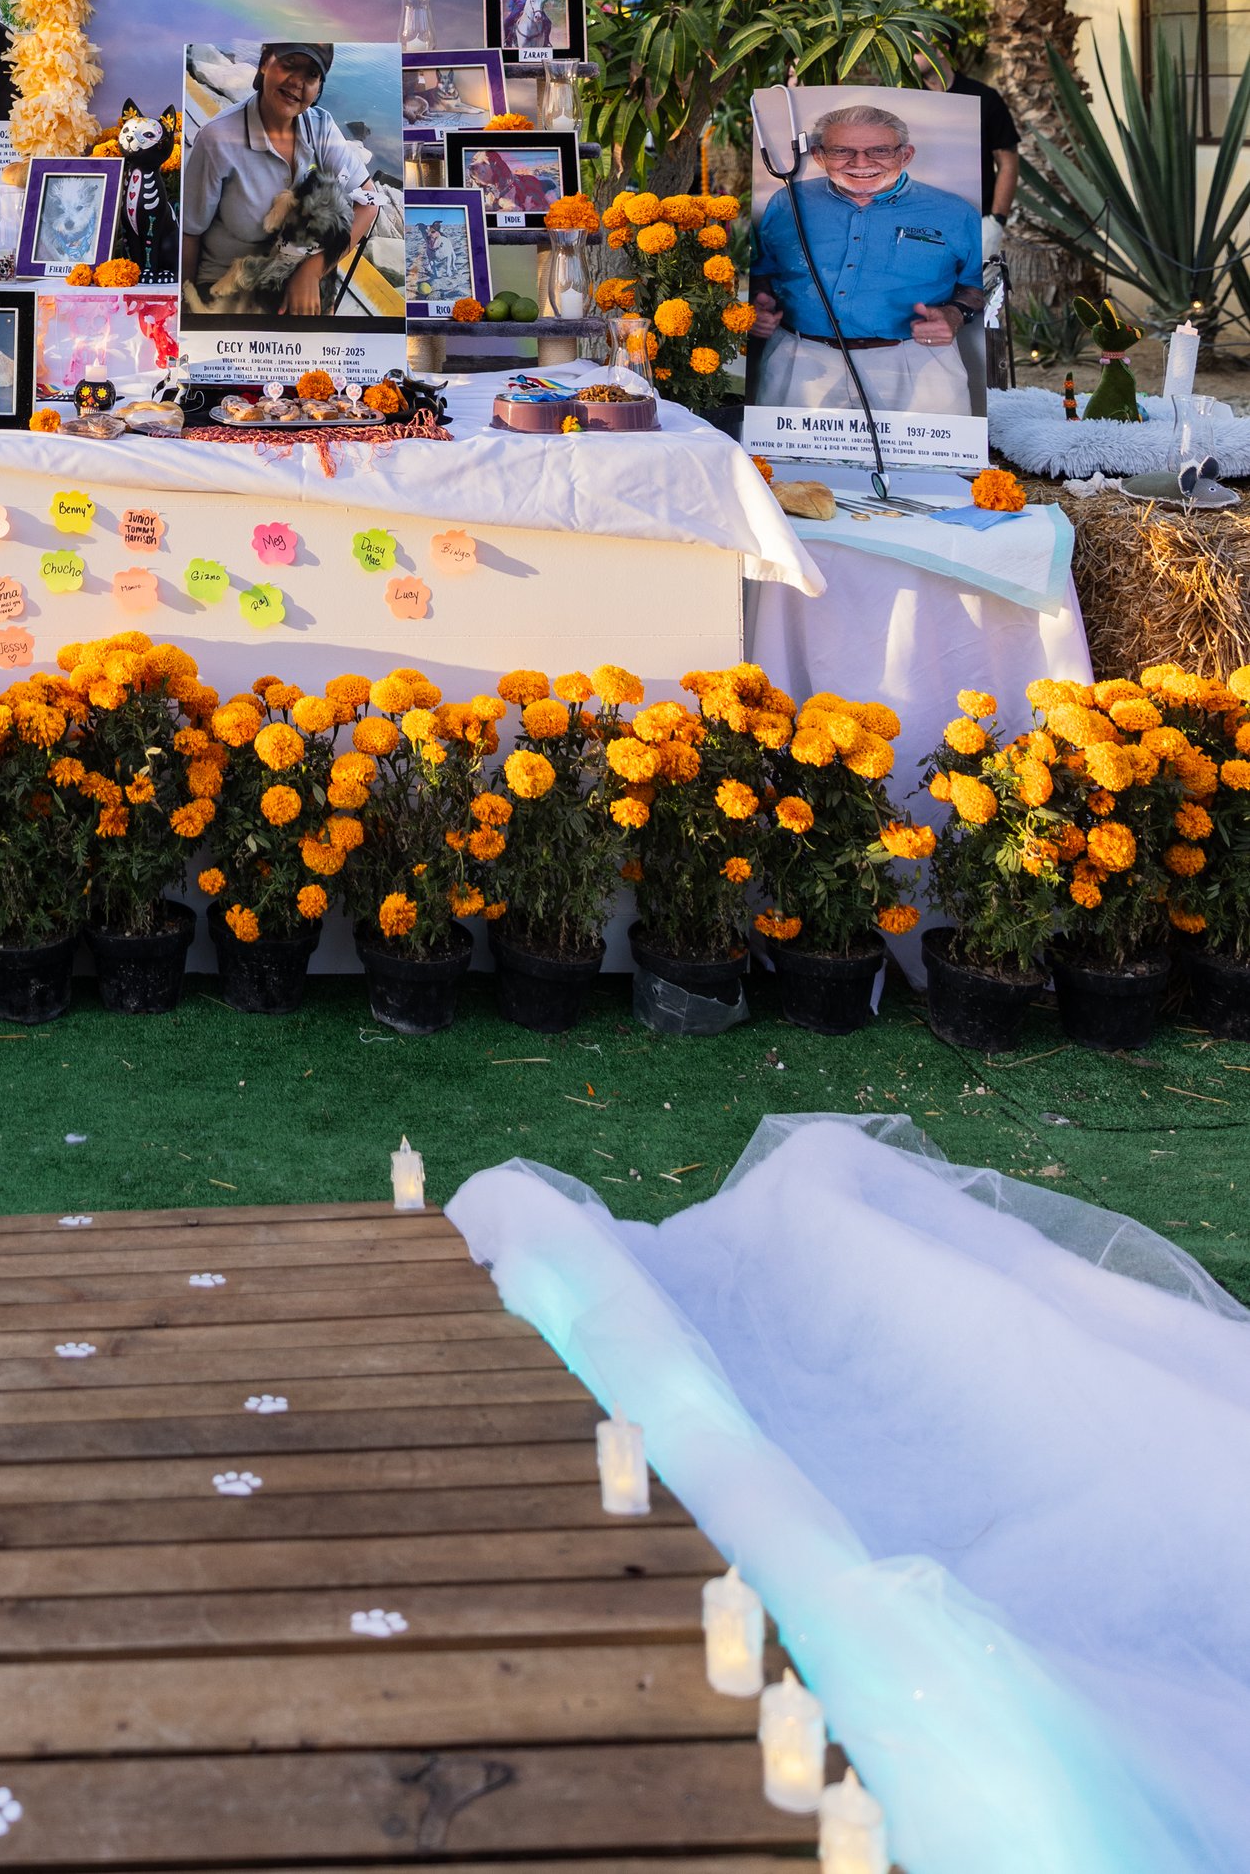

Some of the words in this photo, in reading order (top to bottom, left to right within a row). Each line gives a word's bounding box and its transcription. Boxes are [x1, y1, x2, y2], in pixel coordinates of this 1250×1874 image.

[523, 51, 548, 59] ZARAPE
[505, 216, 521, 224] INDIE
[436, 305, 451, 314] RICO
[217, 340, 243, 354] CECY
[322, 346, 366, 357] 1967-2025
[776, 416, 797, 431] DR.
[802, 417, 844, 432] MARVIN
[907, 426, 951, 439] 1937-2025
[59, 501, 86, 517] Benny
[128, 512, 156, 526] Junior
[125, 524, 155, 536] Tommy
[125, 534, 157, 545] Harrison
[361, 536, 386, 558] Daisy
[365, 554, 381, 566] Mae
[43, 560, 82, 577] Chucho
[190, 571, 221, 581] Gizmo
[395, 588, 419, 605] Lucy
